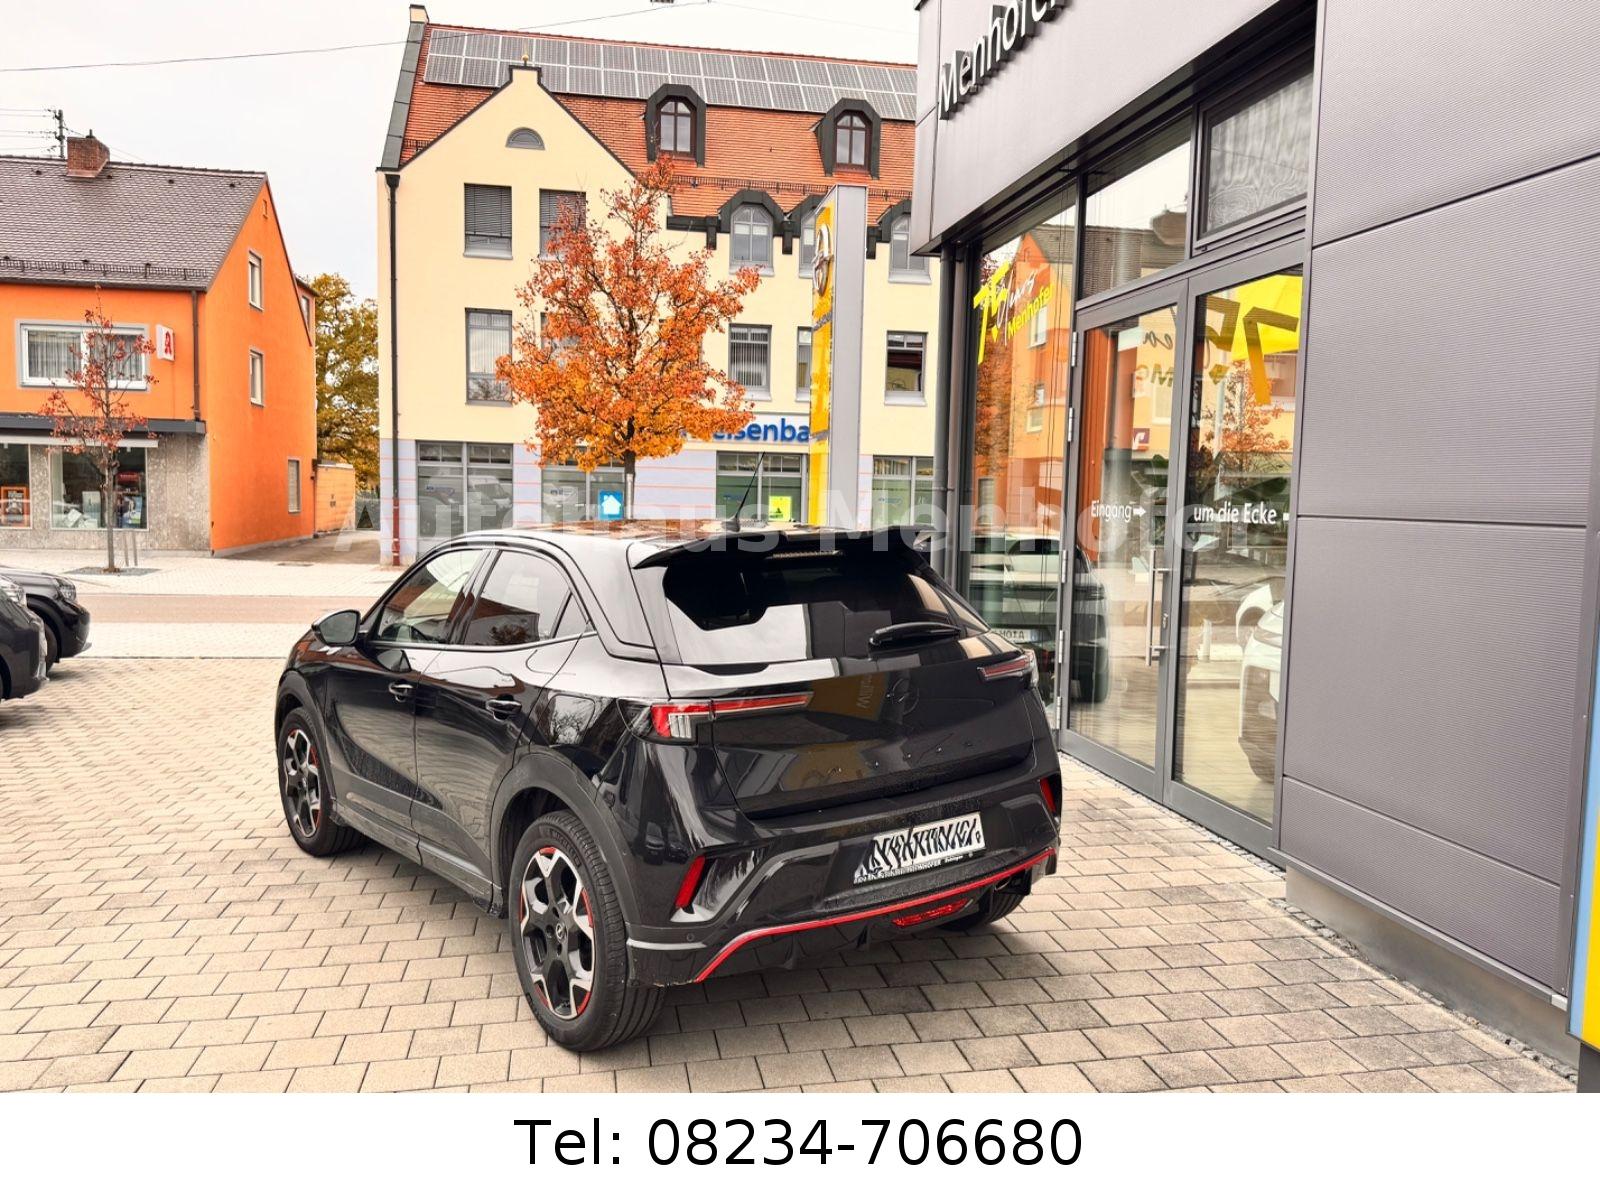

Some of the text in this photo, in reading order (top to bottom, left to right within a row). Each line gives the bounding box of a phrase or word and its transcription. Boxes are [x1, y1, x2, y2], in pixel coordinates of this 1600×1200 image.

[938, 0, 1056, 120] Menhof
[1090, 500, 1132, 523] Eingang
[1193, 501, 1277, 525] um die Ecke
